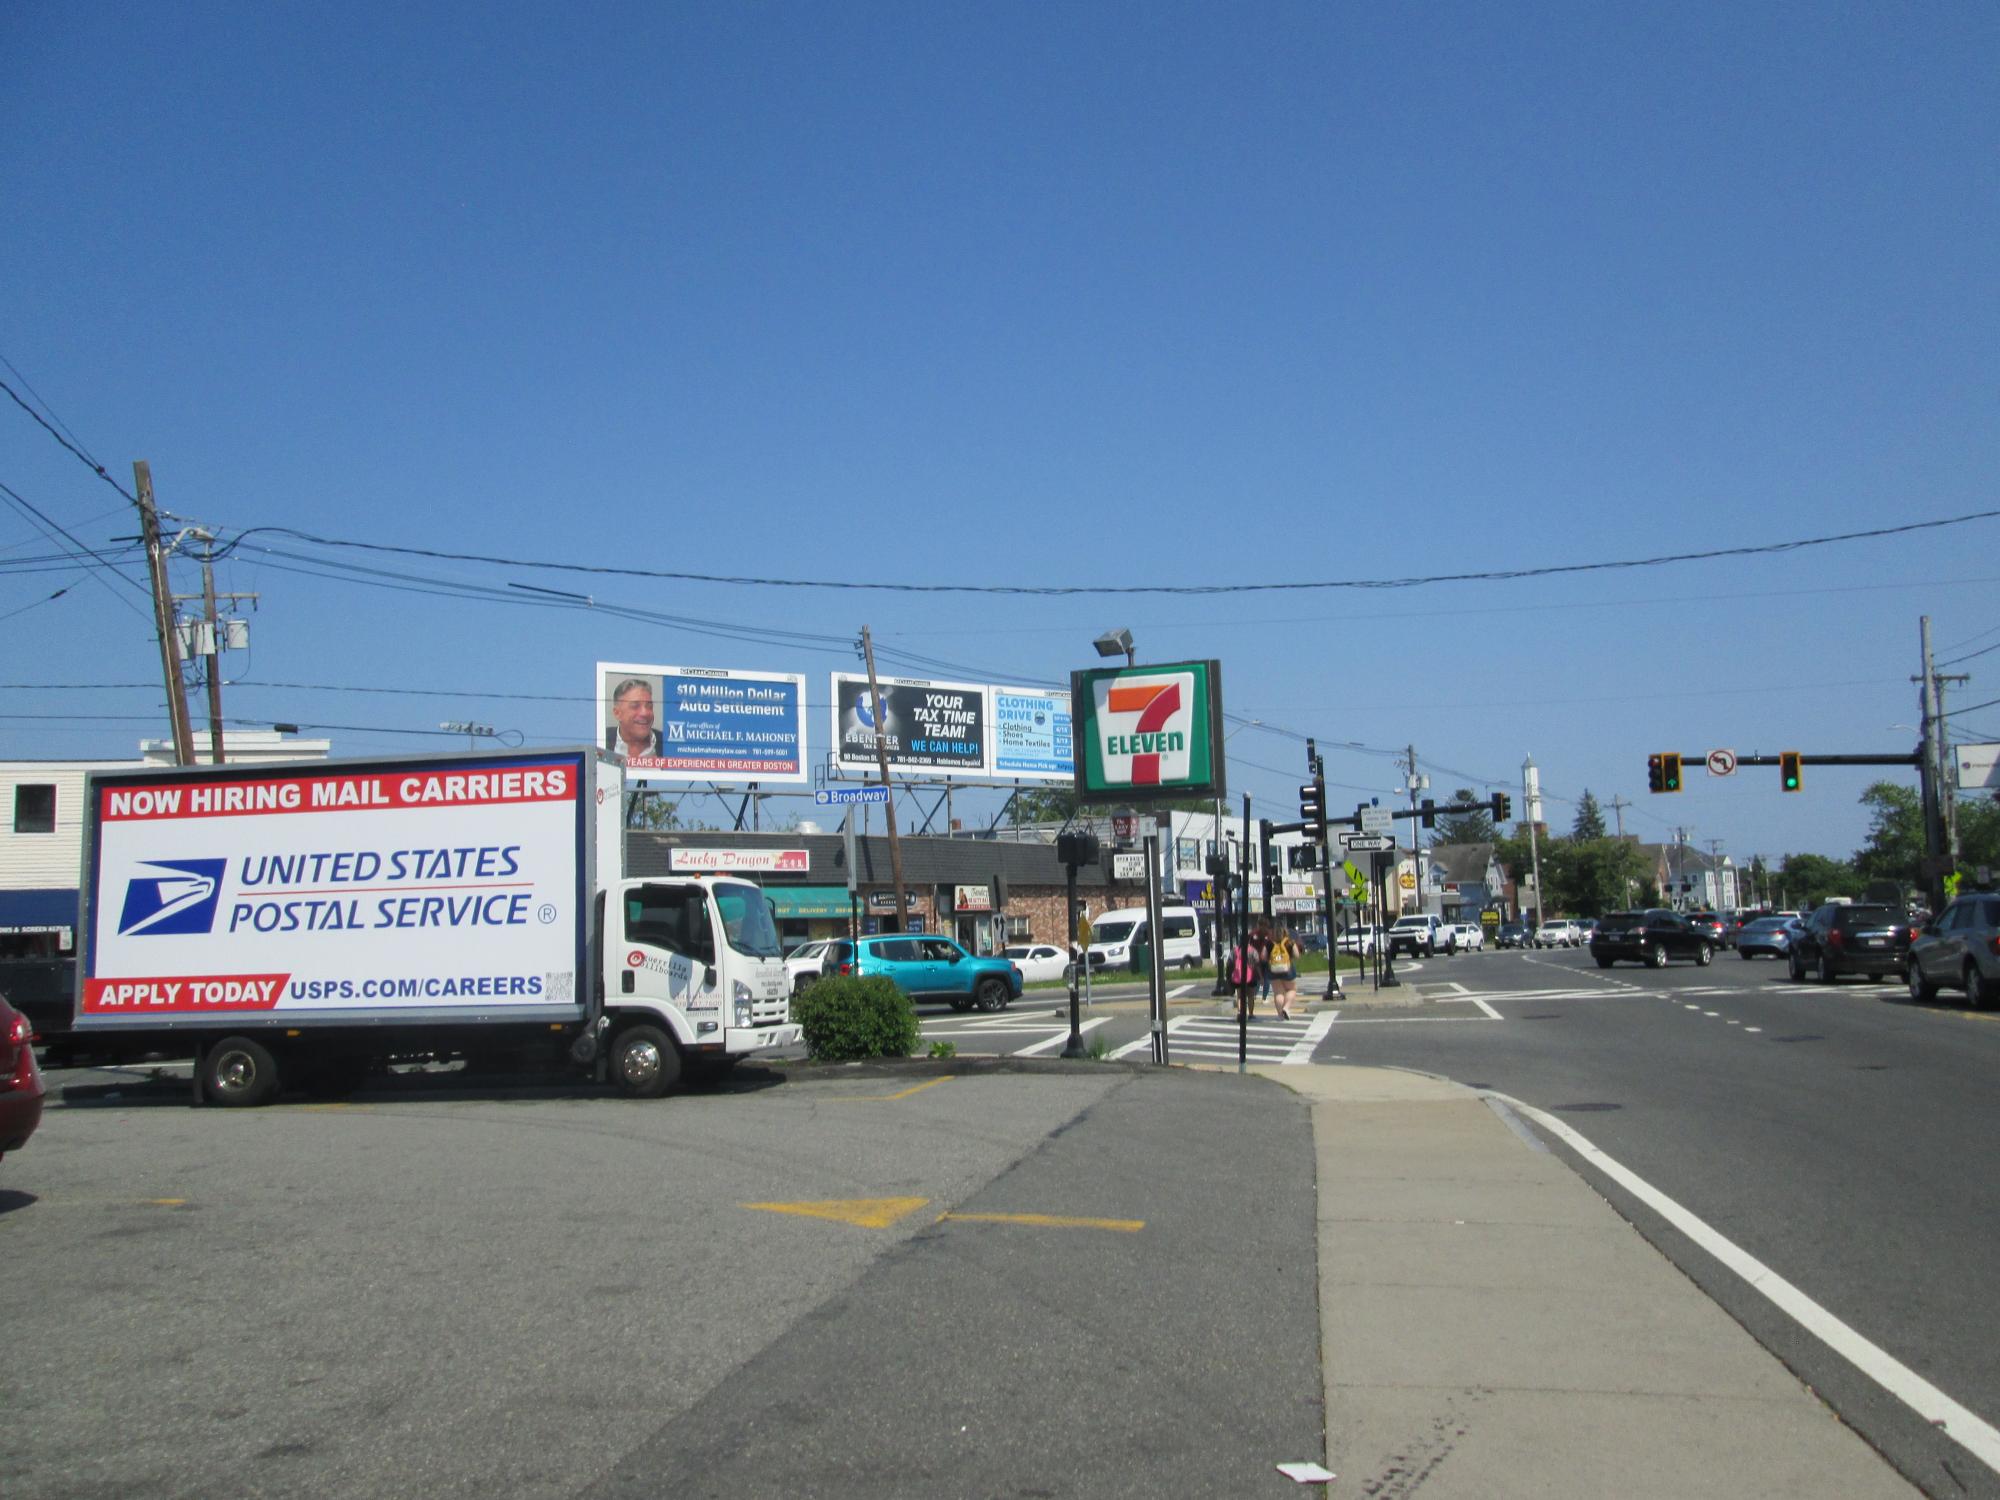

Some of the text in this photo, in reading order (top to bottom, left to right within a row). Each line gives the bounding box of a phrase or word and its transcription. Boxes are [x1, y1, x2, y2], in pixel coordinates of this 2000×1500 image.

[676, 684, 786, 700] $10 Million Dollar
[679, 700, 785, 716] Auto Settlement
[926, 694, 964, 709] YOUR
[998, 697, 1054, 711] CLOTHING
[913, 708, 976, 724] TAX TIME
[998, 709, 1032, 721] DRIVE
[924, 723, 966, 739] TEAM!
[1003, 722, 1032, 733] Clothing
[1003, 731, 1024, 739] Shoes
[686, 730, 796, 743] MICHAEL F. MAHONEY
[845, 733, 899, 745] EBENEER
[1003, 739, 1051, 748] Home Textiles
[911, 740, 979, 755] WE CAN HELP!
[626, 757, 793, 771] YEARS OF EXPERIENCE IN GREATER BOSTON
[110, 770, 567, 816] NOW HIRING MAIL CARRIERS
[831, 790, 887, 804] Broadway
[1367, 840, 1380, 848] WAY
[241, 846, 521, 885] UNITED STATES
[675, 851, 718, 869] Lucky
[722, 852, 770, 867] Dragon
[229, 900, 365, 933] POSTAL
[374, 894, 532, 928] SERVICE
[99, 981, 277, 1006] APPLY TODAY
[290, 976, 542, 999] USPS.COM/CAREERS
